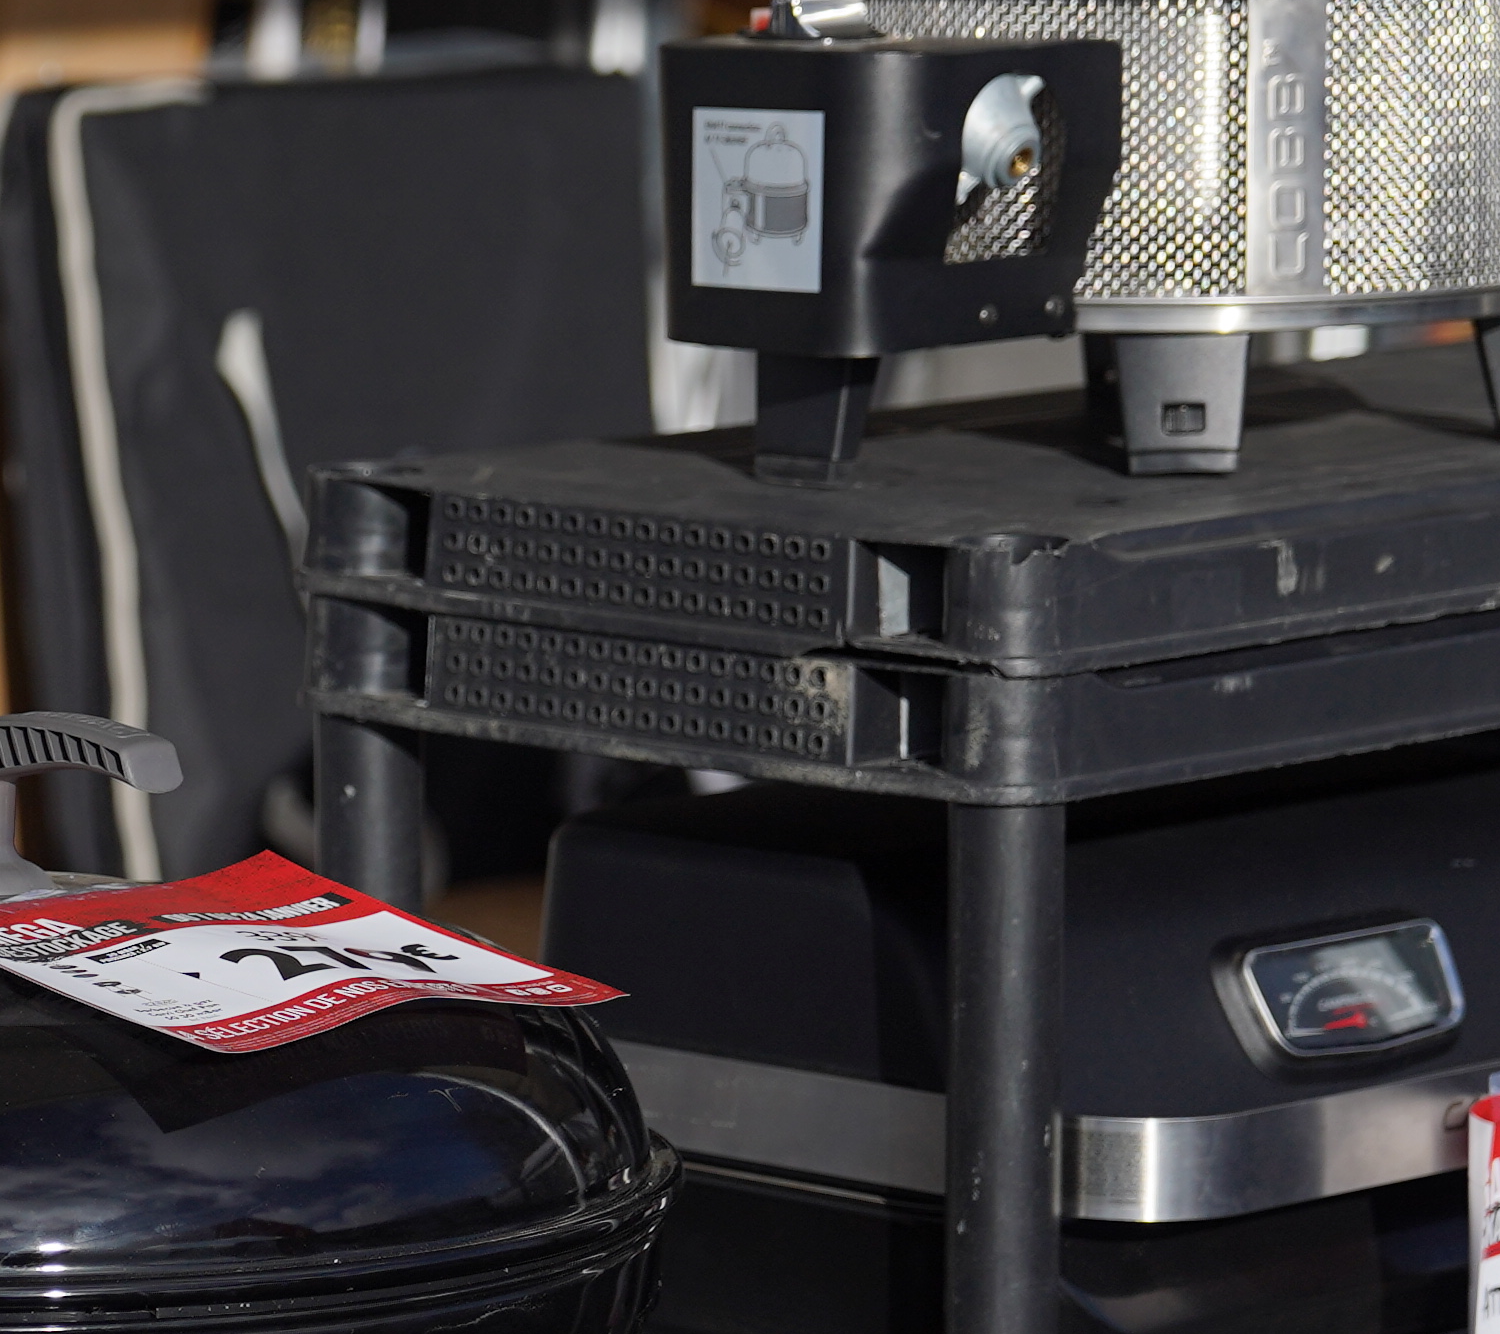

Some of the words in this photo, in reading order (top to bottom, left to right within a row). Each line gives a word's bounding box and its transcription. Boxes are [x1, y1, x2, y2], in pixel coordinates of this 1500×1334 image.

[1267, 73, 1306, 282] COBB
[198, 1002, 317, 1040] SÉLECTION
[308, 990, 348, 1011] DE
[337, 978, 389, 999] NOS
